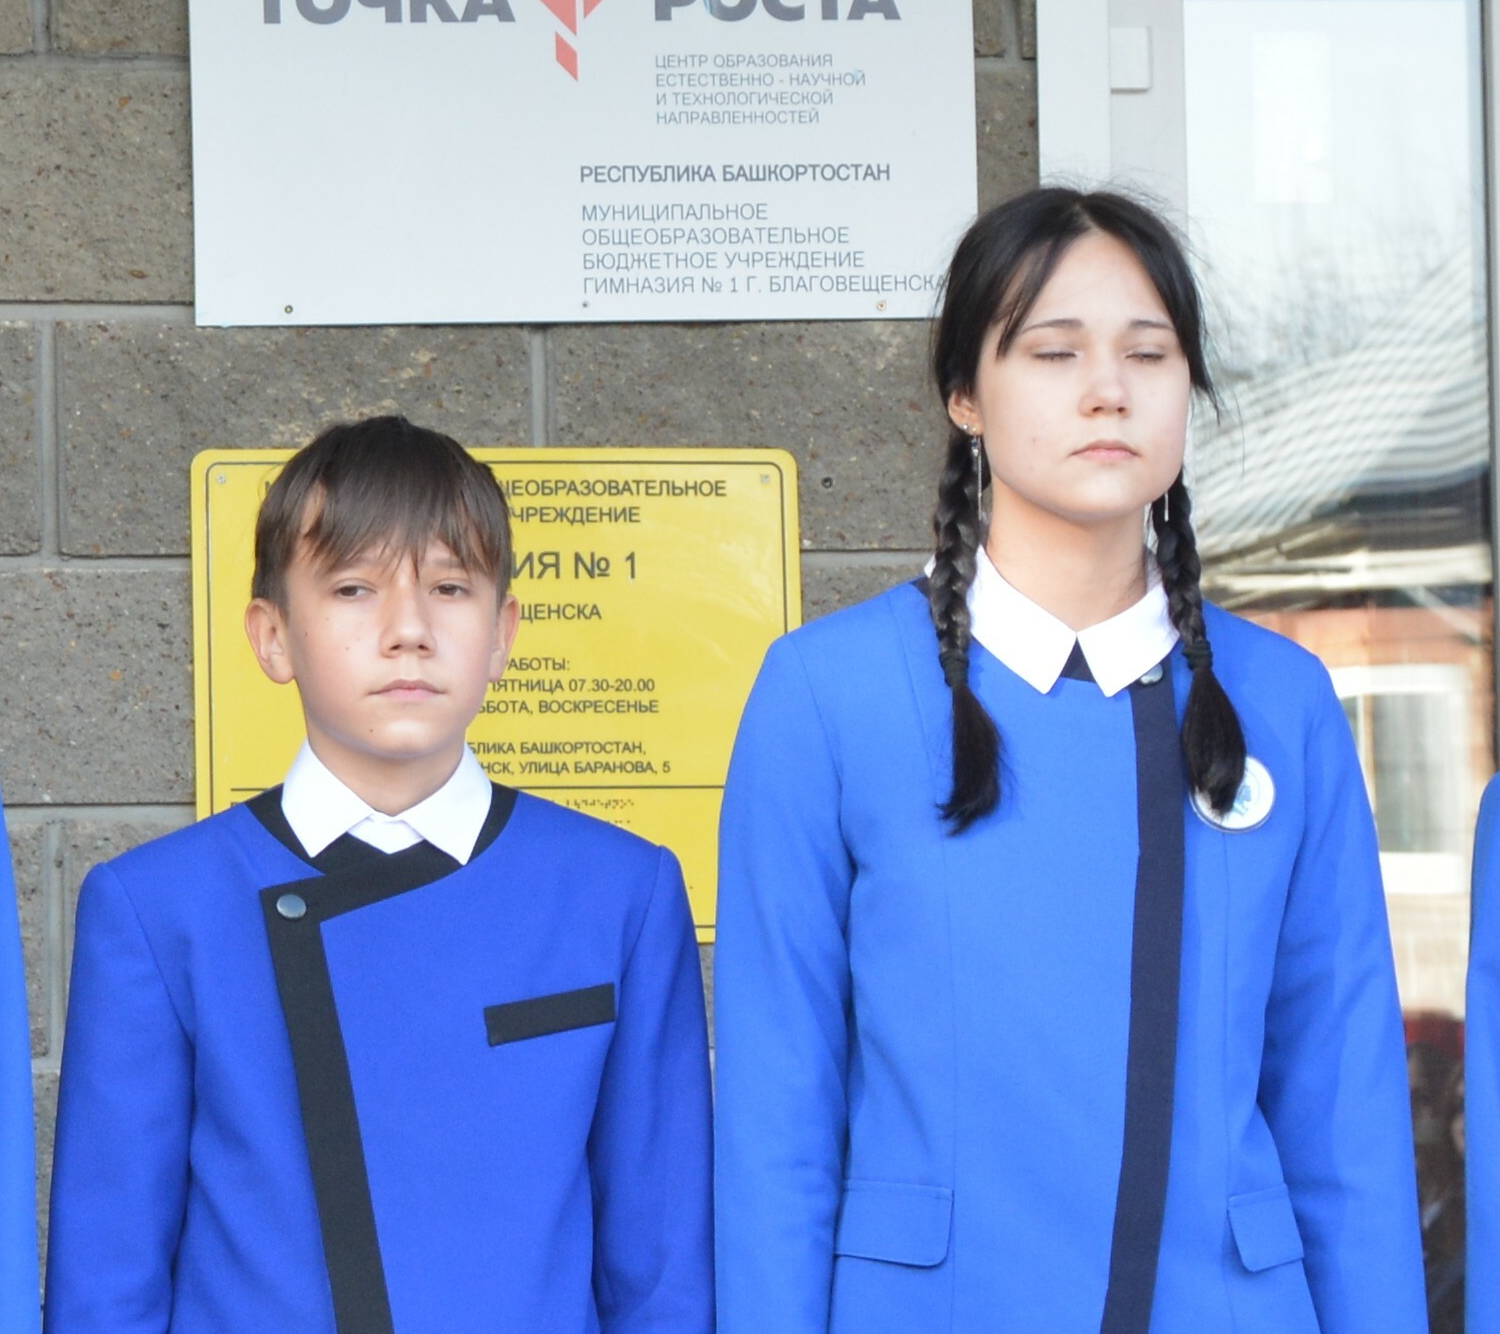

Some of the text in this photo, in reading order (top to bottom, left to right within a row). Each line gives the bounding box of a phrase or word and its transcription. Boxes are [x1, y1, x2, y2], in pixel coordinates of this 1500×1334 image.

[655, 53, 833, 69] ЦЕНТР ОБРАЗОВАНИЯ
[656, 73, 774, 87] ЕСТЕСТВЕННО
[789, 70, 866, 86] НАУЧНОЙ
[656, 89, 833, 106] И ТЕХНОЛОГИЧЕСКОЙ
[657, 108, 819, 125] НАПРАВЛЕННОСТЕЙ
[580, 164, 890, 183] РЕСПУБЛИКА БАШКОРТОСТАН
[582, 203, 768, 223] МУНИЦИПАЛЬНОЕ
[582, 227, 849, 248] ОБЩЕОБРАЗОВАТЕЛЬНОЕ
[583, 251, 864, 272] БЮДЖЕТНОЕ УЧРЕЖДЕНИЕ
[583, 276, 695, 294] ГИМНАЗИЯ
[702, 276, 723, 293] №
[730, 277, 738, 293] 1
[747, 276, 762, 293] Г.
[503, 480, 727, 499] ЕОБРАЗОВАТЕЛЬНОЕ
[511, 506, 641, 525] ЧРЕЖДЕНИЕ
[574, 551, 611, 579] №
[625, 551, 636, 579] 1
[506, 657, 570, 671] АБОТЫ:
[569, 678, 655, 692] 07.30-20.00
[539, 700, 659, 713] ВОСКРЕСЕНЬЕ
[520, 742, 646, 756] БАШКОРТОСТАН,
[519, 762, 570, 776] УЛИЦА
[574, 761, 658, 775] БАРАНОВА,
[662, 761, 671, 773] 5
